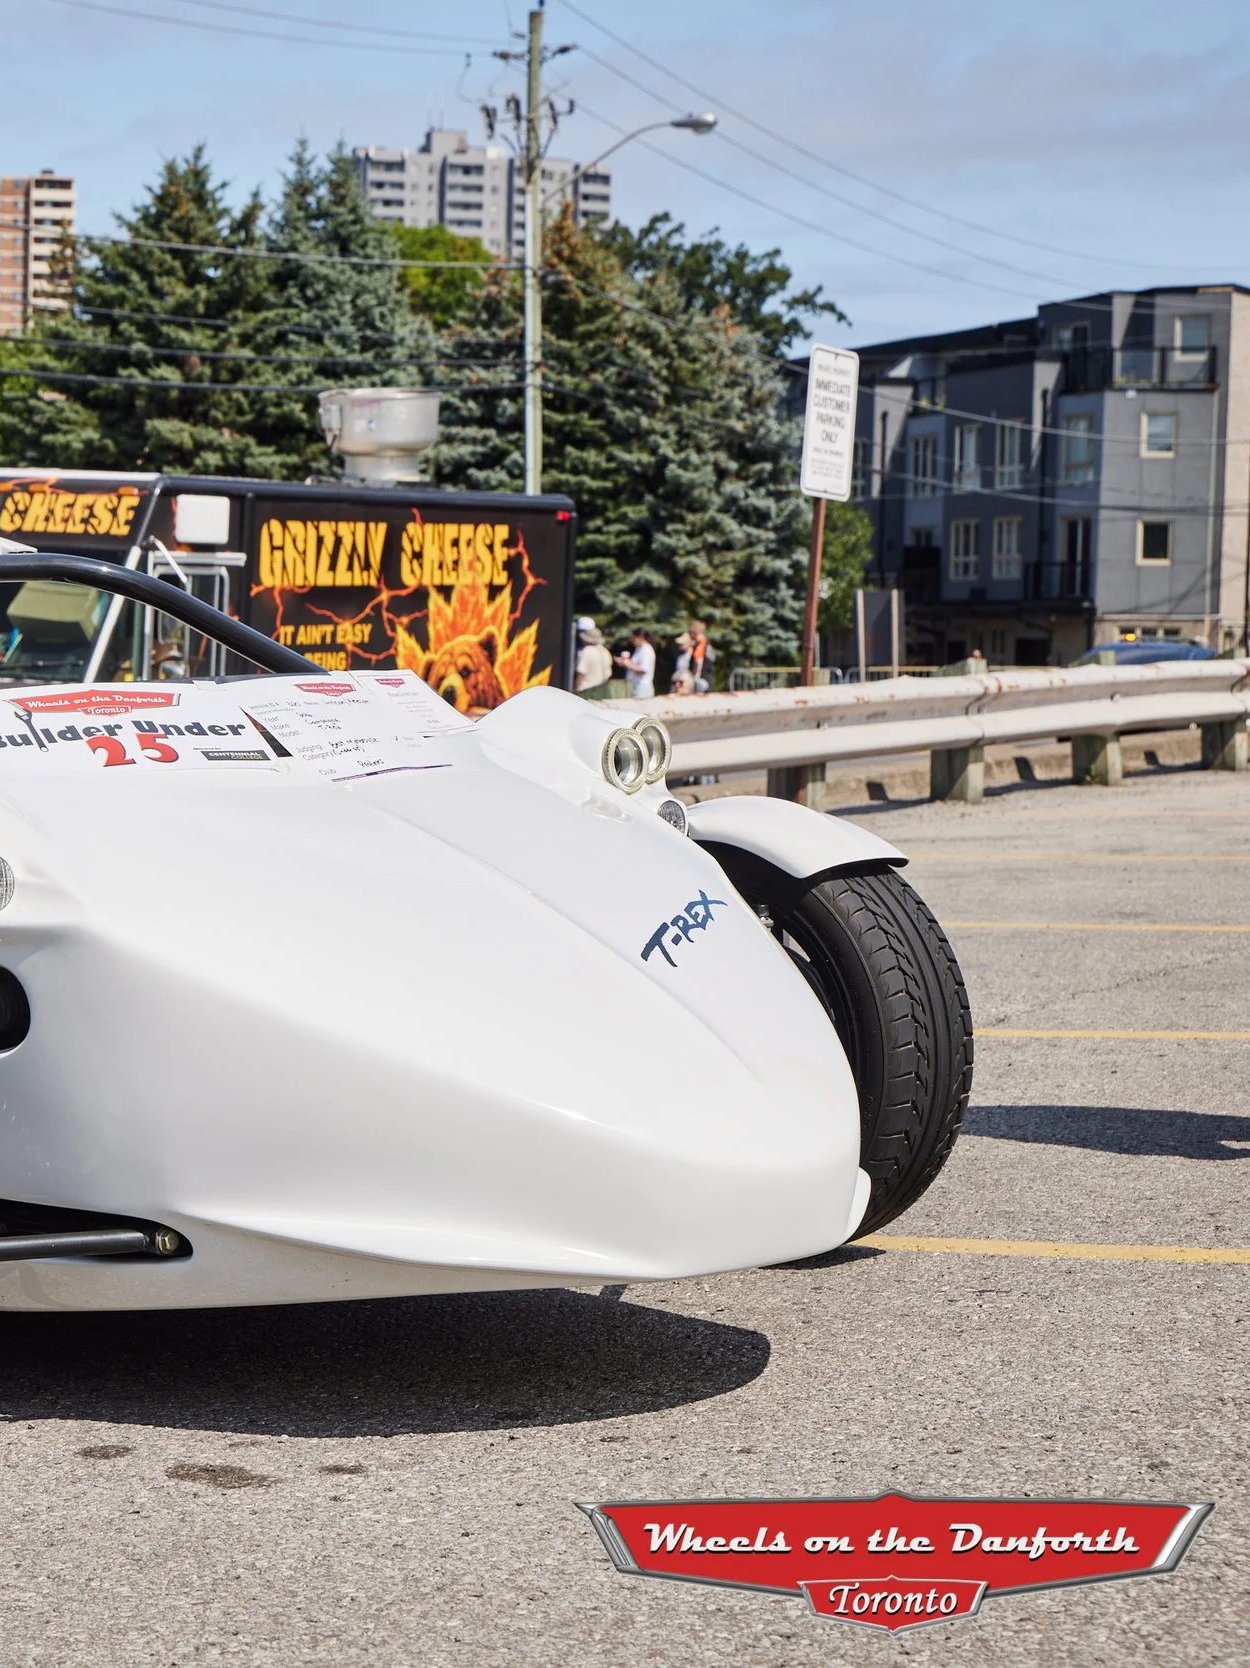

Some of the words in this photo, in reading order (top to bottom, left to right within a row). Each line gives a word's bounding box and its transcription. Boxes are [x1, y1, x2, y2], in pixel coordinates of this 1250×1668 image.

[0, 491, 140, 536] CHEESE
[259, 518, 388, 587] GRIZZLY
[401, 522, 510, 586] CHEESE
[279, 626, 295, 645] IT
[296, 624, 334, 645] AIN'T
[336, 623, 372, 644] EASY
[25, 699, 71, 708] Wheels
[112, 694, 166, 704] Danforth
[88, 706, 126, 714] Toronto
[131, 719, 245, 737] Under
[86, 733, 179, 768] 25
[640, 888, 729, 968] T-REX
